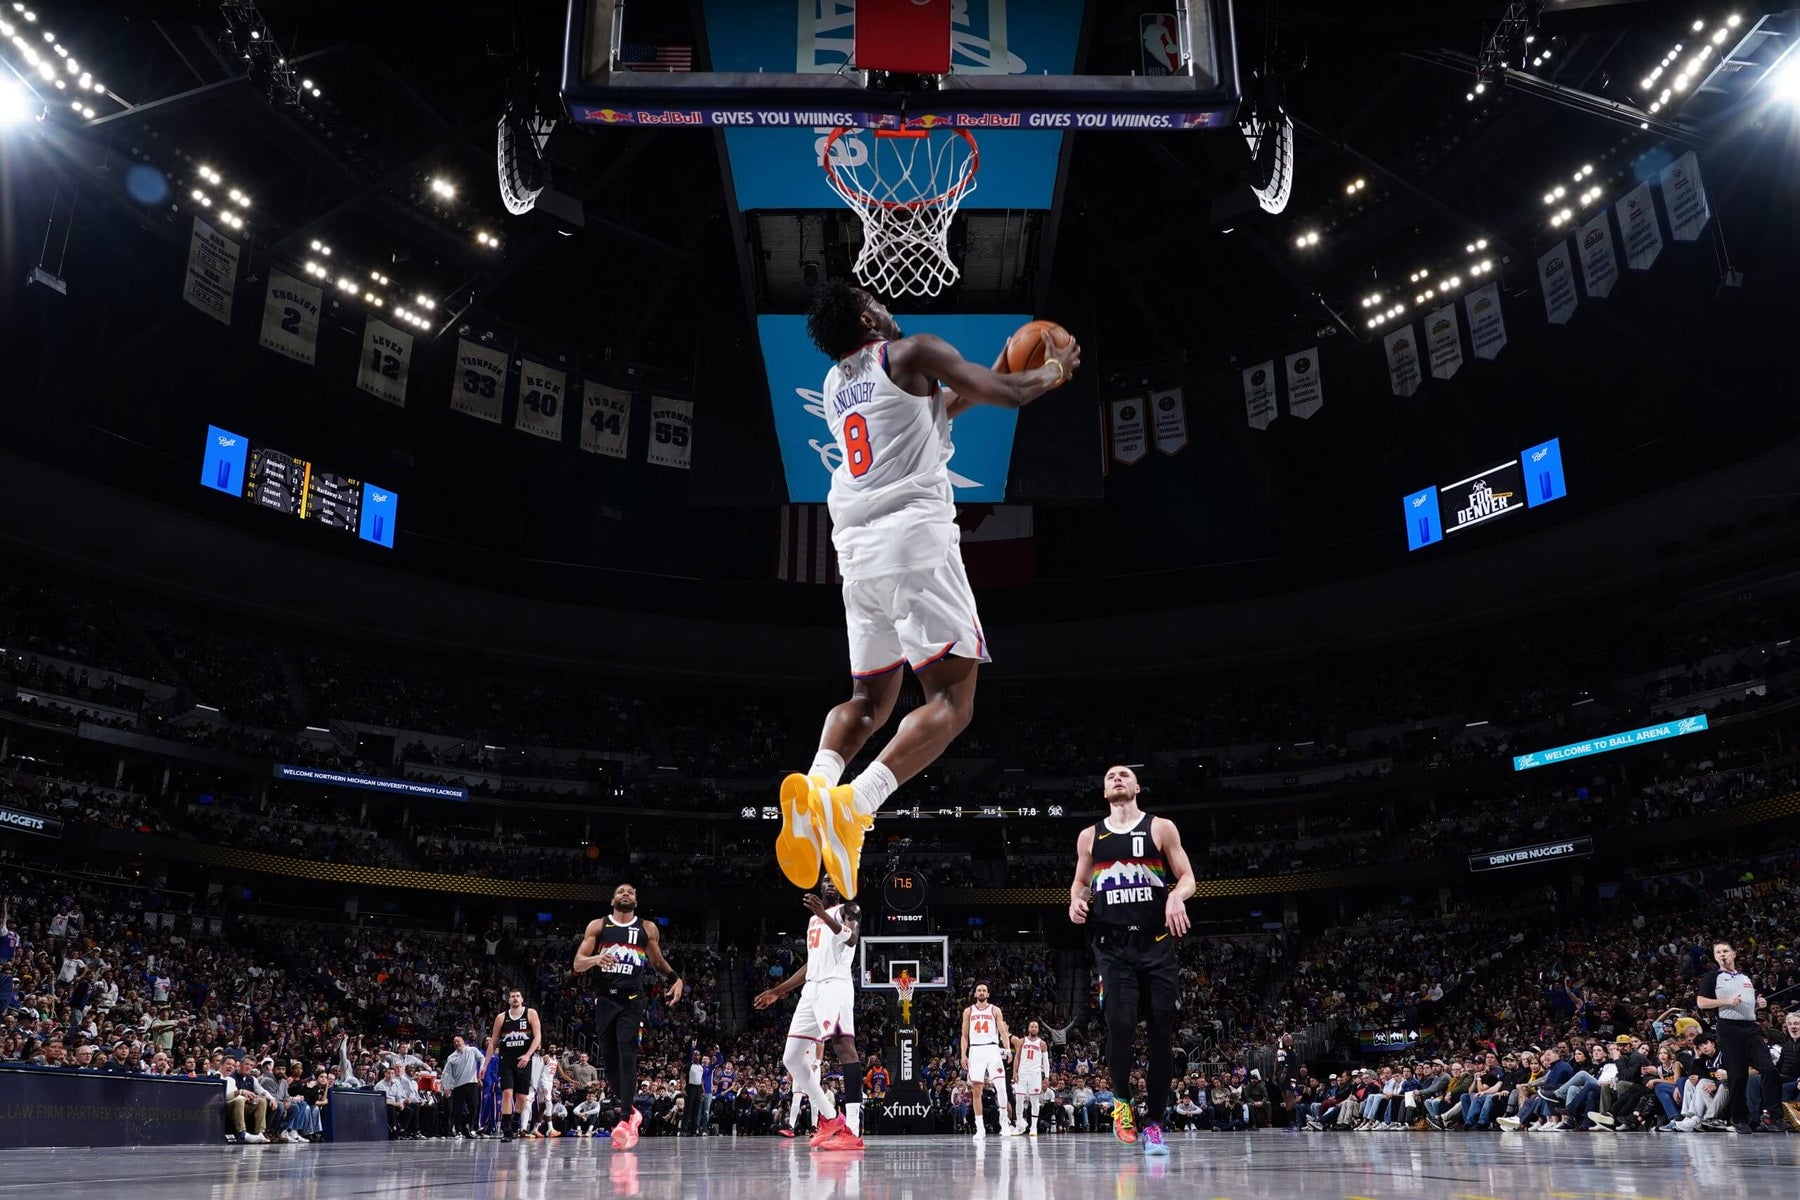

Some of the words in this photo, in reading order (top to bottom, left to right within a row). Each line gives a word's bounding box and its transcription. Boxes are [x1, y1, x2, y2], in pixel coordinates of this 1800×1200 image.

[711, 112, 754, 125] GIVES
[757, 112, 790, 125] YOU
[793, 112, 858, 126] WIIINGS.
[1029, 114, 1071, 127] GIVES
[1076, 114, 1108, 127] YOU
[1111, 114, 1173, 128] WIIINGS.
[272, 289, 318, 315] ENGLISH
[281, 307, 302, 336] 2
[372, 334, 404, 356] LEVER
[372, 348, 401, 381] 12
[461, 356, 504, 377] THOMPSON
[463, 370, 497, 400] 33
[526, 377, 561, 395] BECK
[525, 390, 558, 418] 40
[588, 397, 626, 413] ISSEL
[833, 382, 876, 418] ANUNOBY
[590, 410, 621, 436] 44
[655, 421, 690, 447] 55
[843, 412, 873, 479] 8
[1468, 488, 1493, 508] FOR
[1457, 497, 1509, 525] DENVER
[1545, 744, 1592, 761] WELCOME
[1593, 740, 1607, 750] TO
[1609, 735, 1634, 747] BALL
[1636, 727, 1671, 741] ARENA
[283, 768, 314, 778] WELCOME
[314, 772, 346, 782] NORTHERN
[347, 776, 376, 786] MICHIGAN
[377, 780, 409, 790] UNIVERSITY
[436, 788, 462, 797] LACROSSE
[1018, 807, 1037, 816] 17.8
[1132, 836, 1144, 858] 0
[1489, 851, 1528, 865] DENVER
[1529, 843, 1574, 859] NUGGETS
[1106, 887, 1153, 905] DENVER
[628, 930, 639, 946] 11
[519, 1021, 527, 1030] 15
[974, 1021, 989, 1034] 44
[903, 1040, 912, 1081] UMB
[8, 1104, 34, 1119] LAW
[37, 1104, 64, 1119] FIRM
[67, 1105, 112, 1120] PARTNER
[883, 1102, 931, 1118] xfinity
